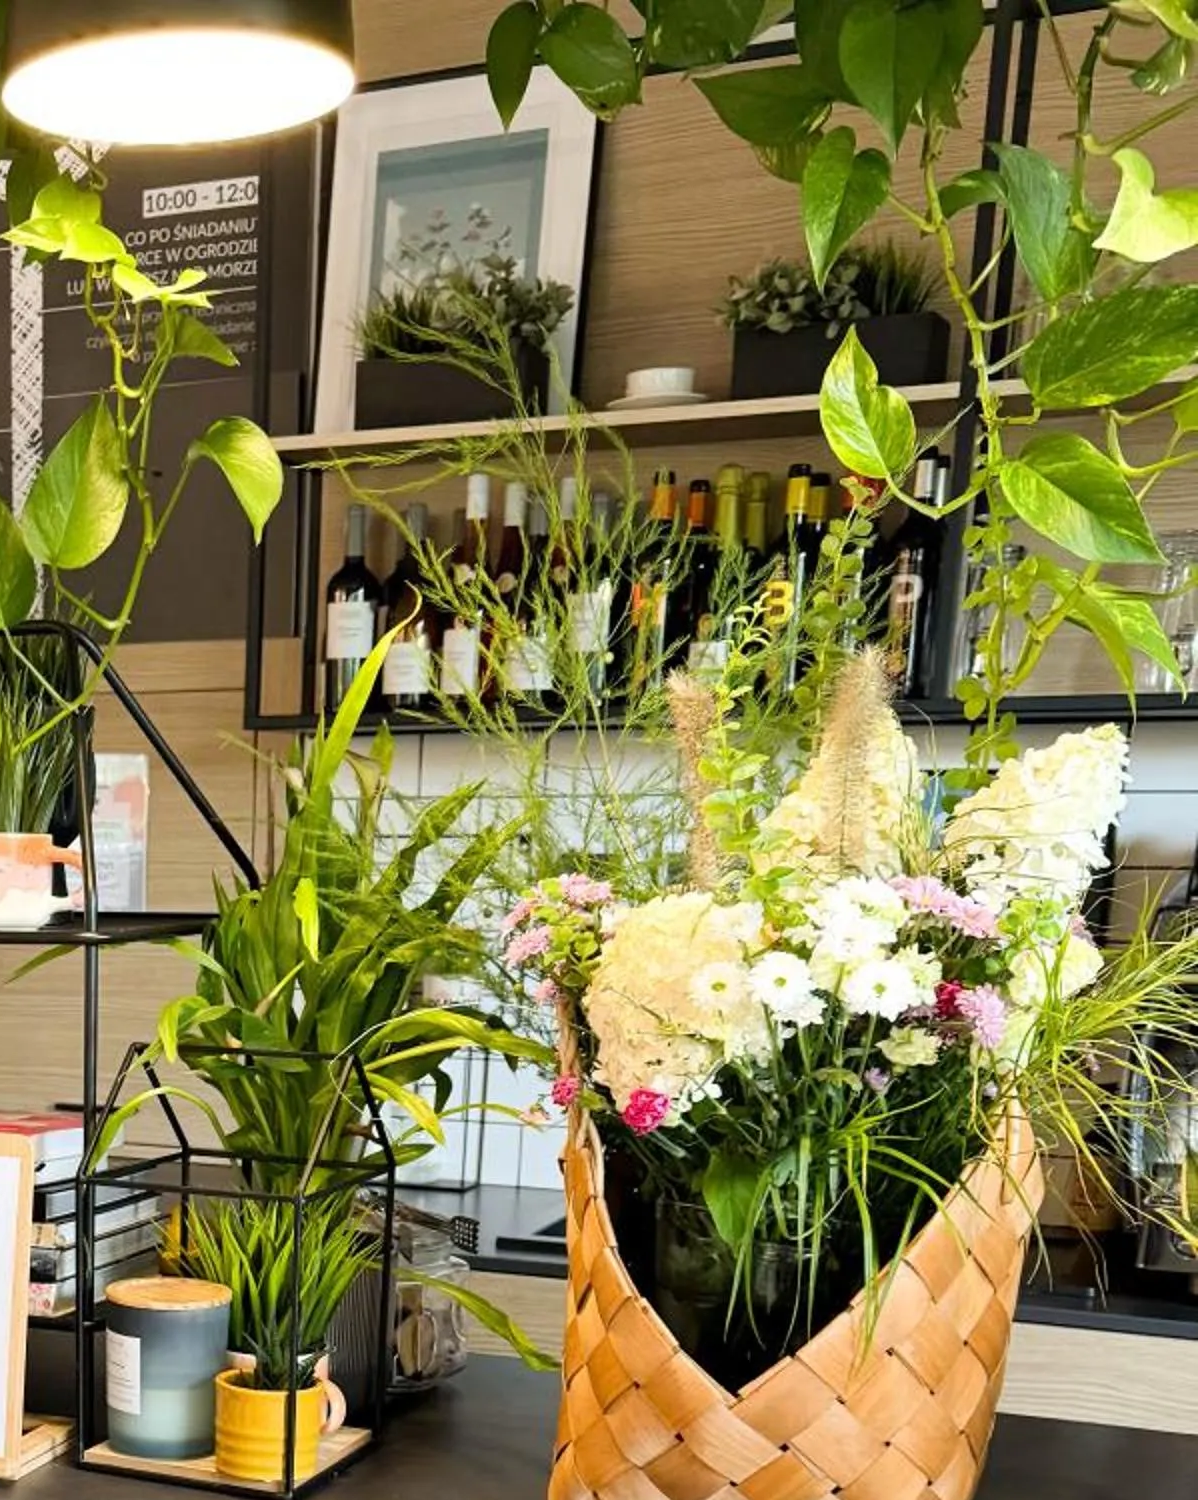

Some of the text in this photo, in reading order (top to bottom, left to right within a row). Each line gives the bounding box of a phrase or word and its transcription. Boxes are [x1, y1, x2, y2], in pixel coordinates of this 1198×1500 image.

[145, 188, 197, 214] 10:00
[215, 180, 258, 205] 12:0
[125, 231, 147, 248] CO
[149, 228, 171, 244] PO
[136, 250, 163, 267] RCE
[165, 247, 183, 264] W
